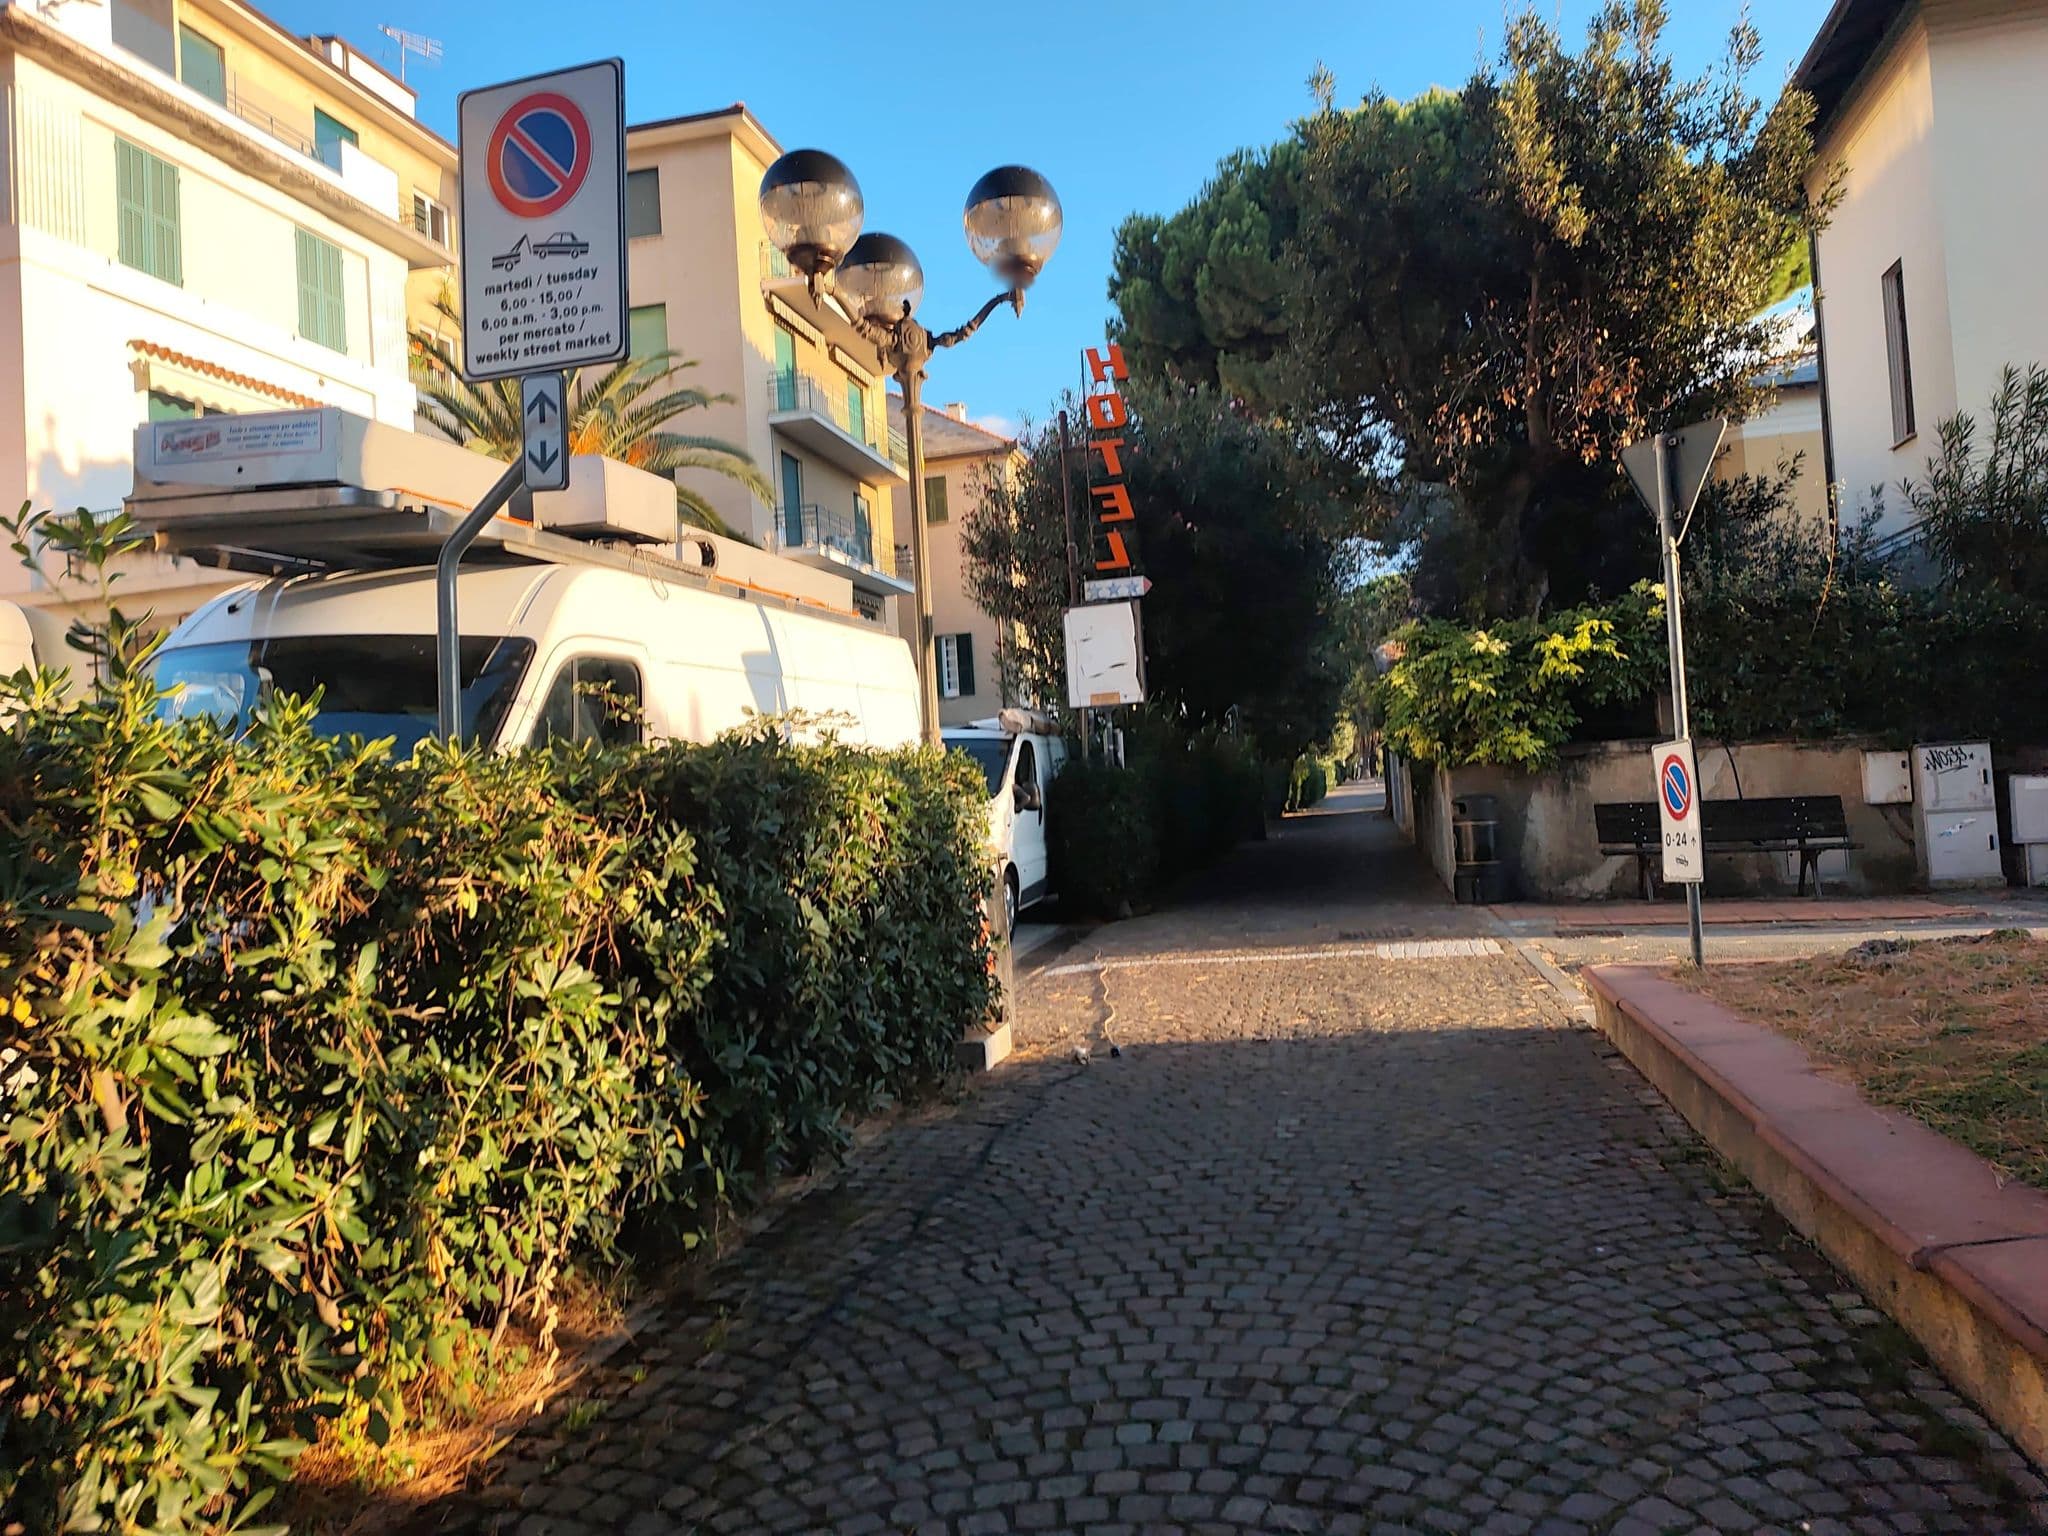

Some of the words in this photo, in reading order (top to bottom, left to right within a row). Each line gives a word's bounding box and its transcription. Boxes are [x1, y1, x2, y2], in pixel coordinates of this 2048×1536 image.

[547, 266, 598, 286] tuesday
[500, 299, 527, 312] 6,00
[539, 289, 573, 305] 15,00
[481, 317, 508, 331] 6,00
[511, 312, 537, 326] a.m.
[550, 306, 578, 320] 3,00
[581, 304, 604, 317] p.m.
[499, 334, 520, 347] per
[523, 322, 575, 341] mercato
[475, 347, 519, 364] weekly
[523, 341, 562, 357] street
[565, 331, 611, 351] market
[1665, 832, 1687, 847] 0-24
